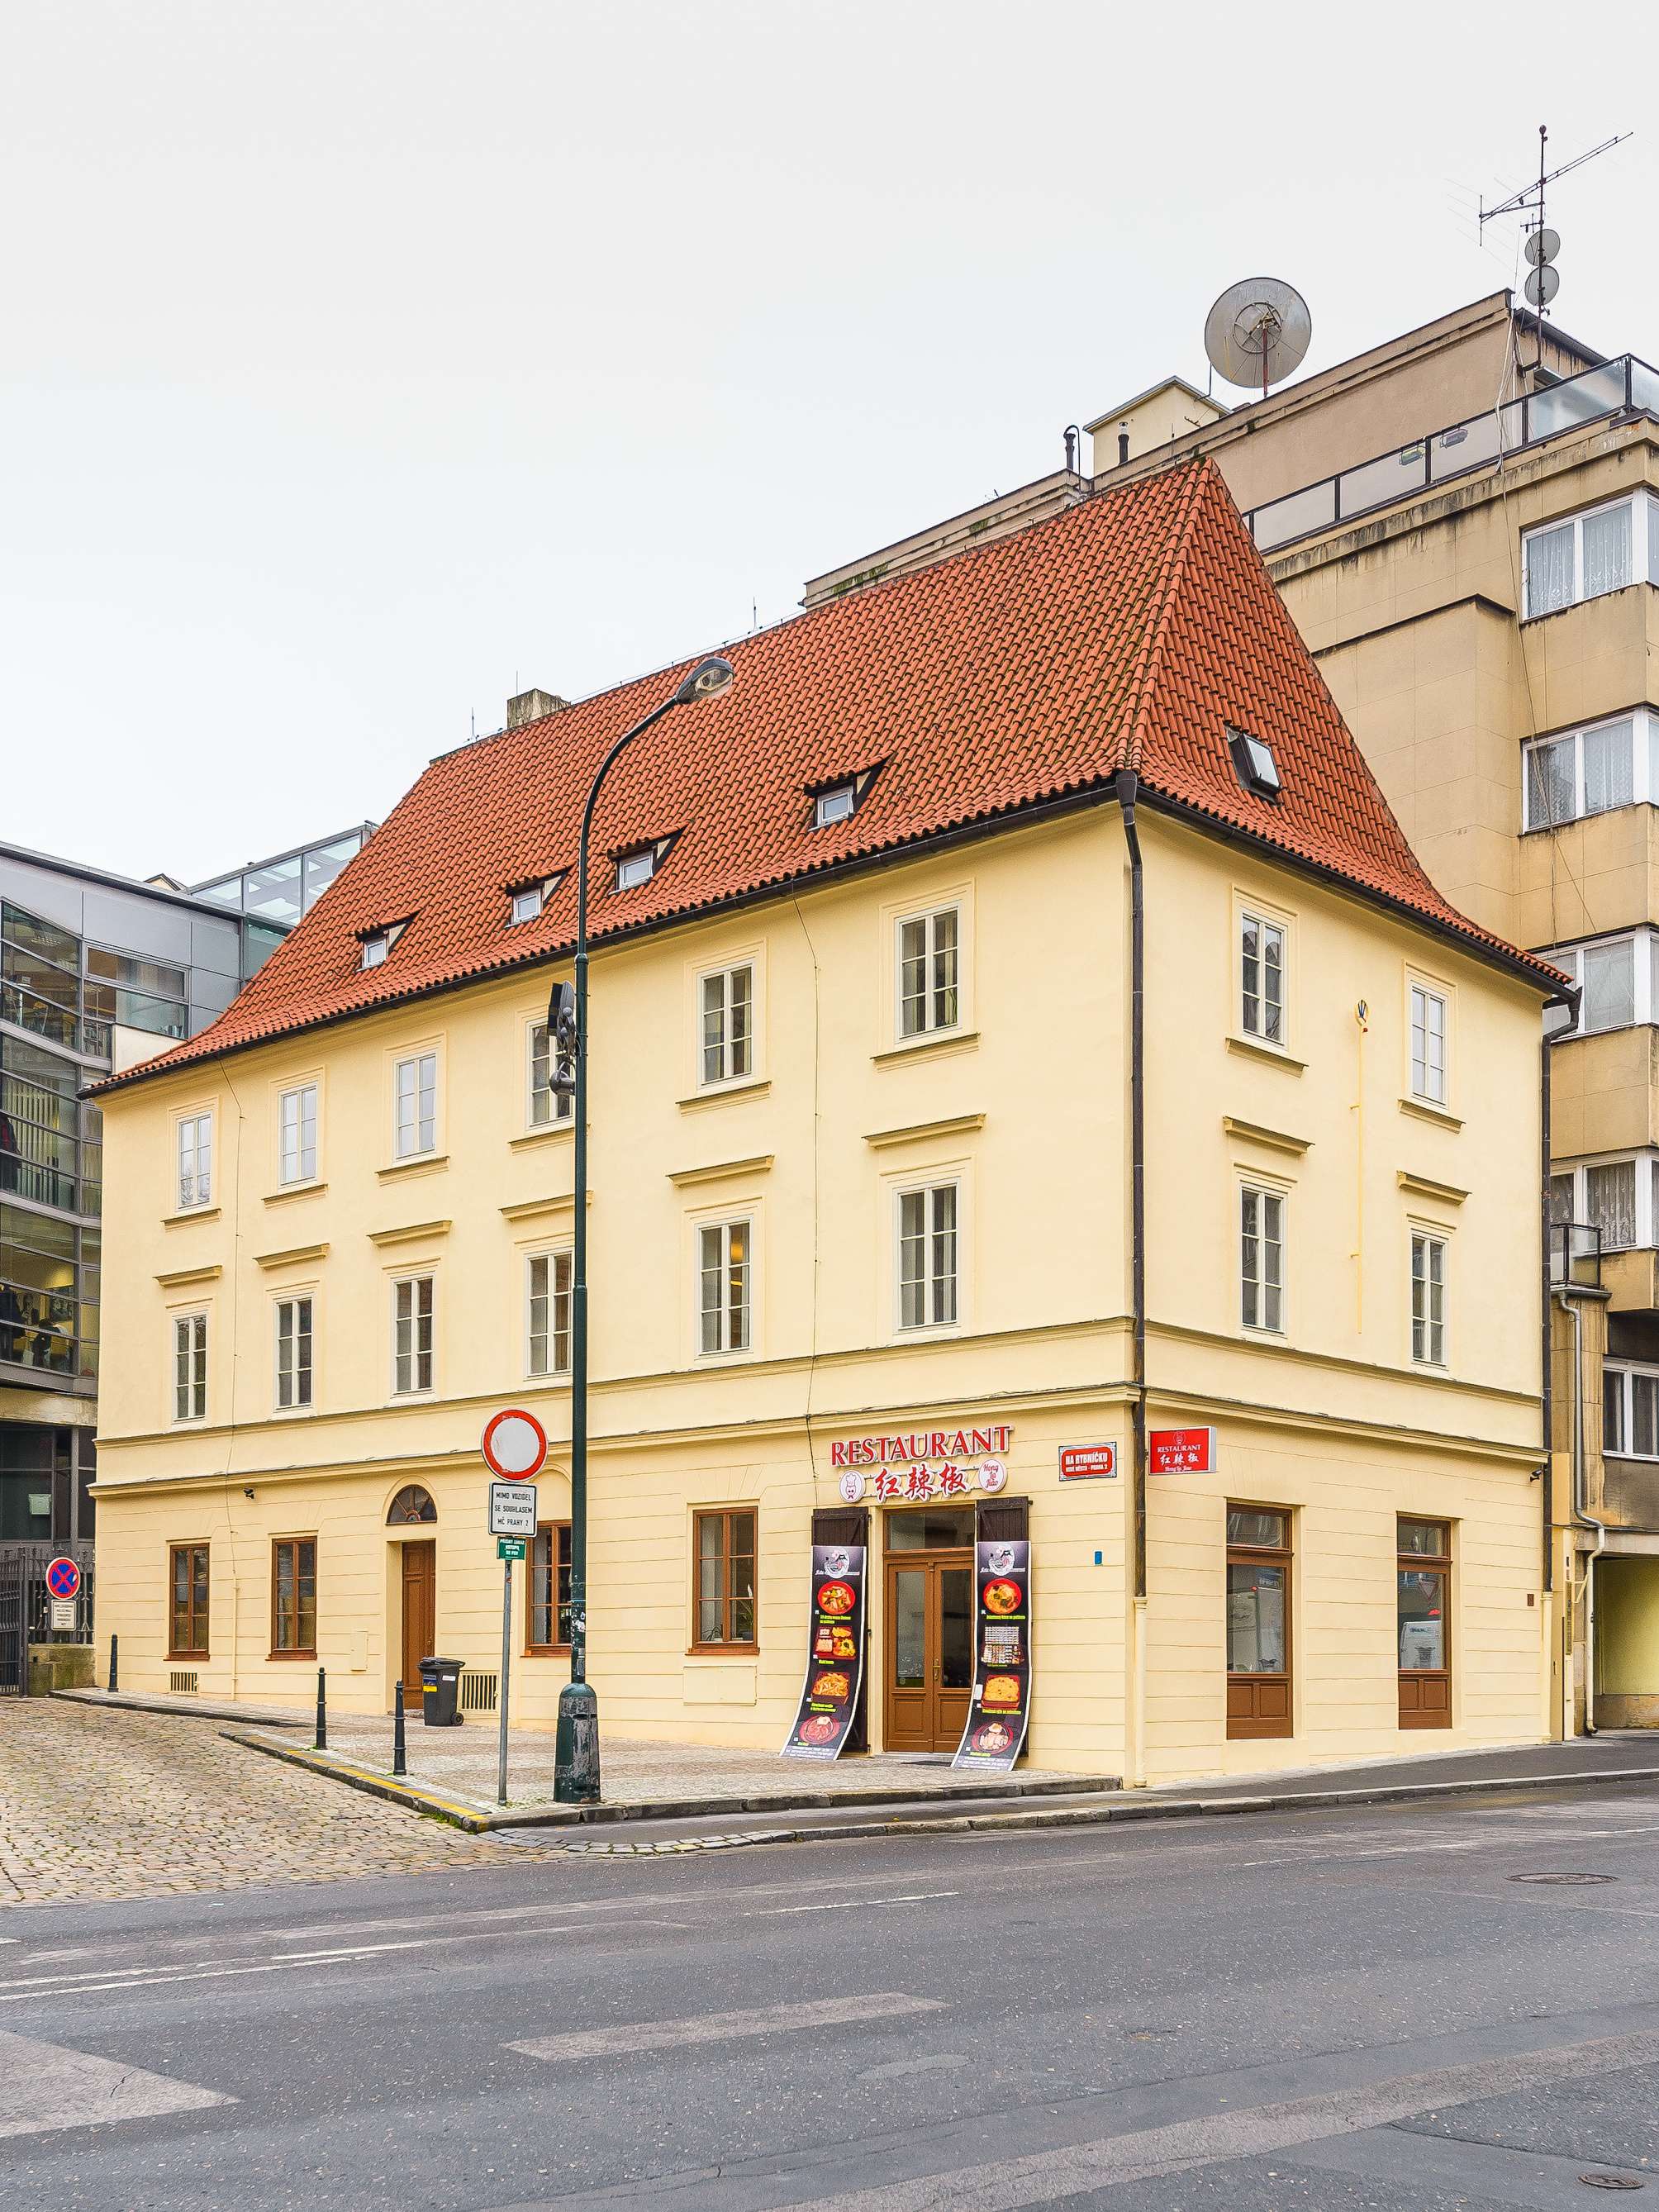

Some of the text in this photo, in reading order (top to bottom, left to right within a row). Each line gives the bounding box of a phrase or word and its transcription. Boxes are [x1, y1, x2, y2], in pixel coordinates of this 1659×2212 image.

[831, 1425, 1010, 1466] RESTAURANT
[1157, 1444, 1202, 1453] RESTAURANT
[1065, 1451, 1108, 1465] NA RYBNÍČKU
[874, 1462, 966, 1501] 红辣椒
[512, 1493, 531, 1501] VOZIDEL
[503, 1506, 533, 1514] SOUHLASEM
[506, 1519, 523, 1527] PRAHY
